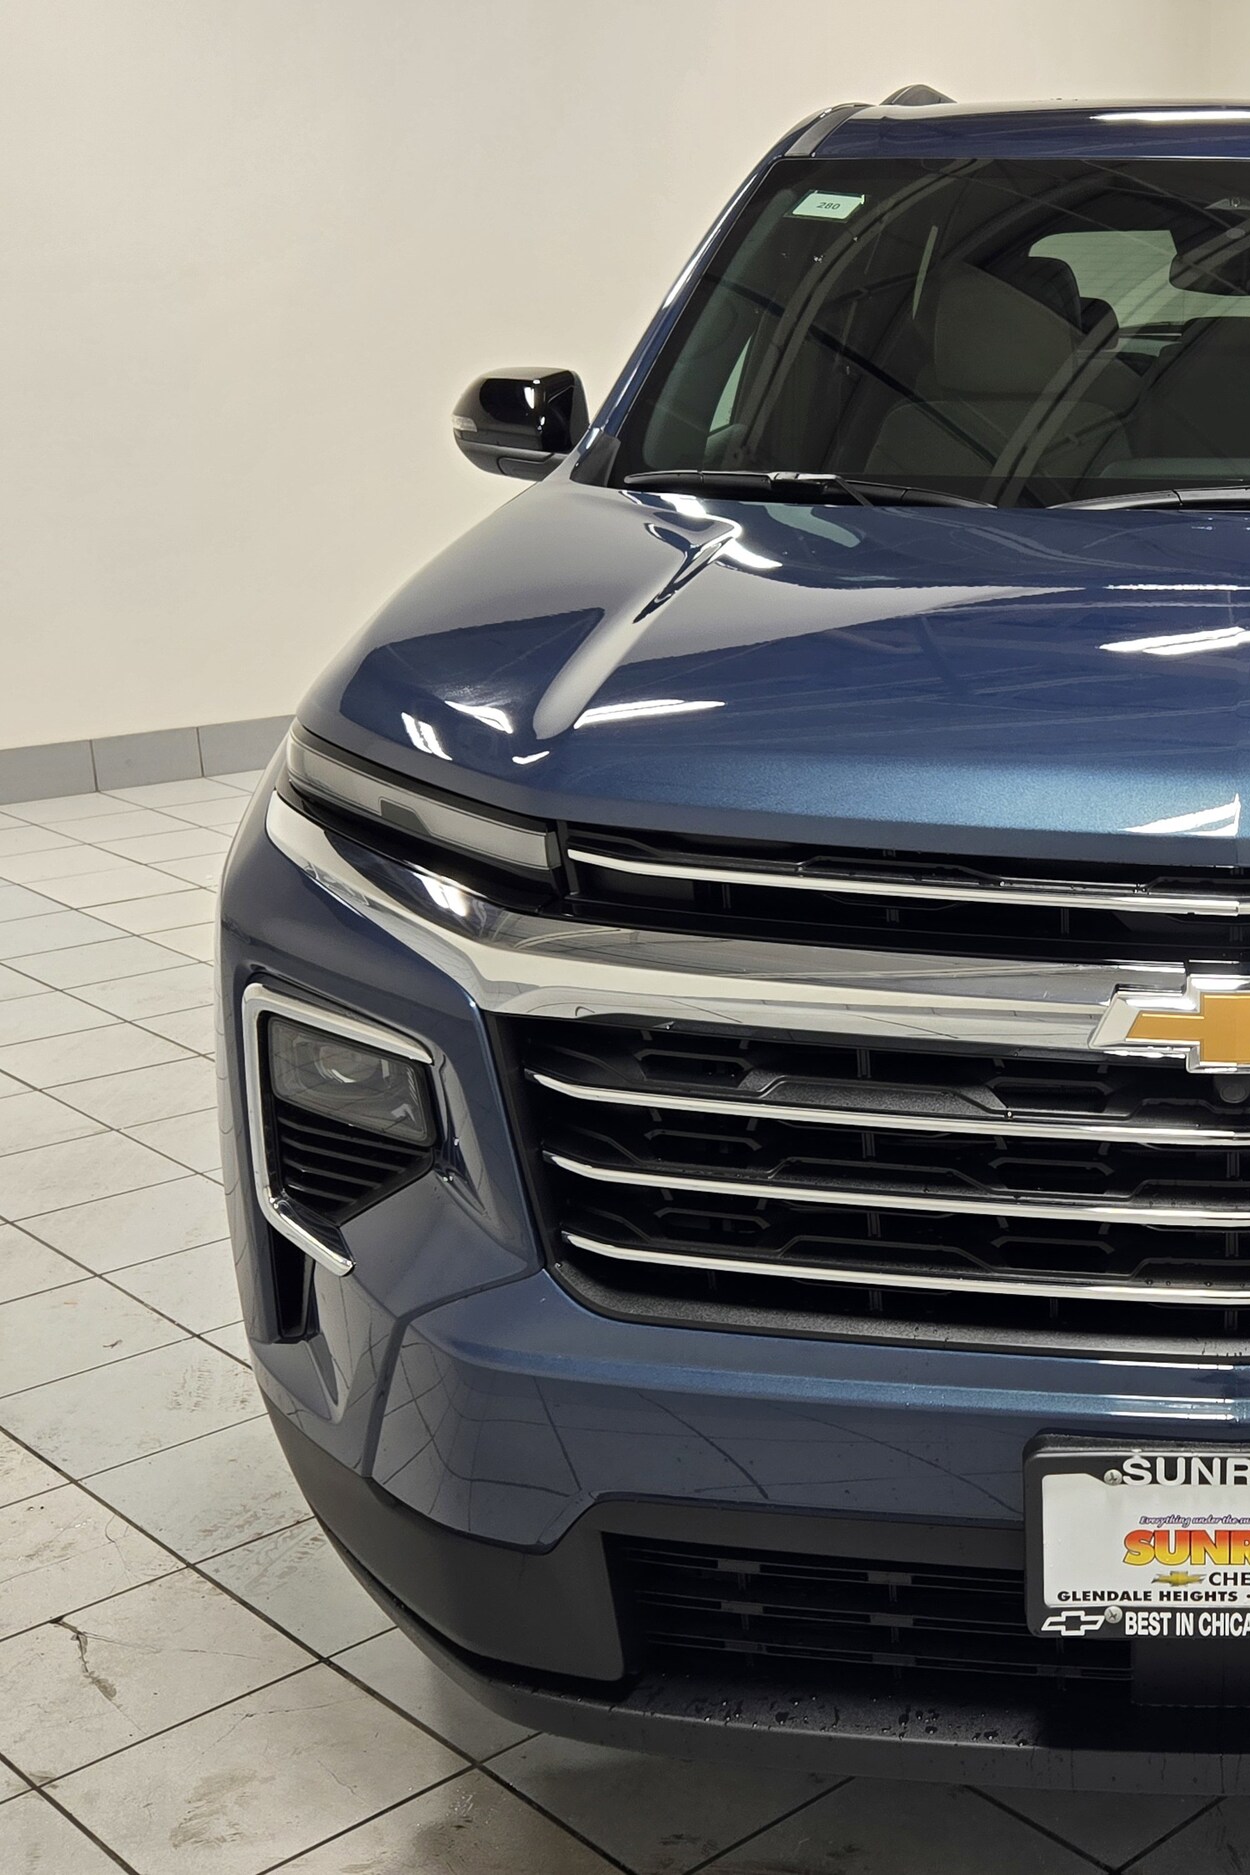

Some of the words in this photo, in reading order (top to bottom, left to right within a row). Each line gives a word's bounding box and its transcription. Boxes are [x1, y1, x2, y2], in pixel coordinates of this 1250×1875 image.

[816, 202, 841, 210] 280
[1139, 1514, 1191, 1528] Everything
[1057, 1590, 1152, 1602] GLENDALE
[1159, 1590, 1238, 1602] HEIGHTS
[1125, 1611, 1172, 1636] BEST
[1176, 1612, 1194, 1636] IN
